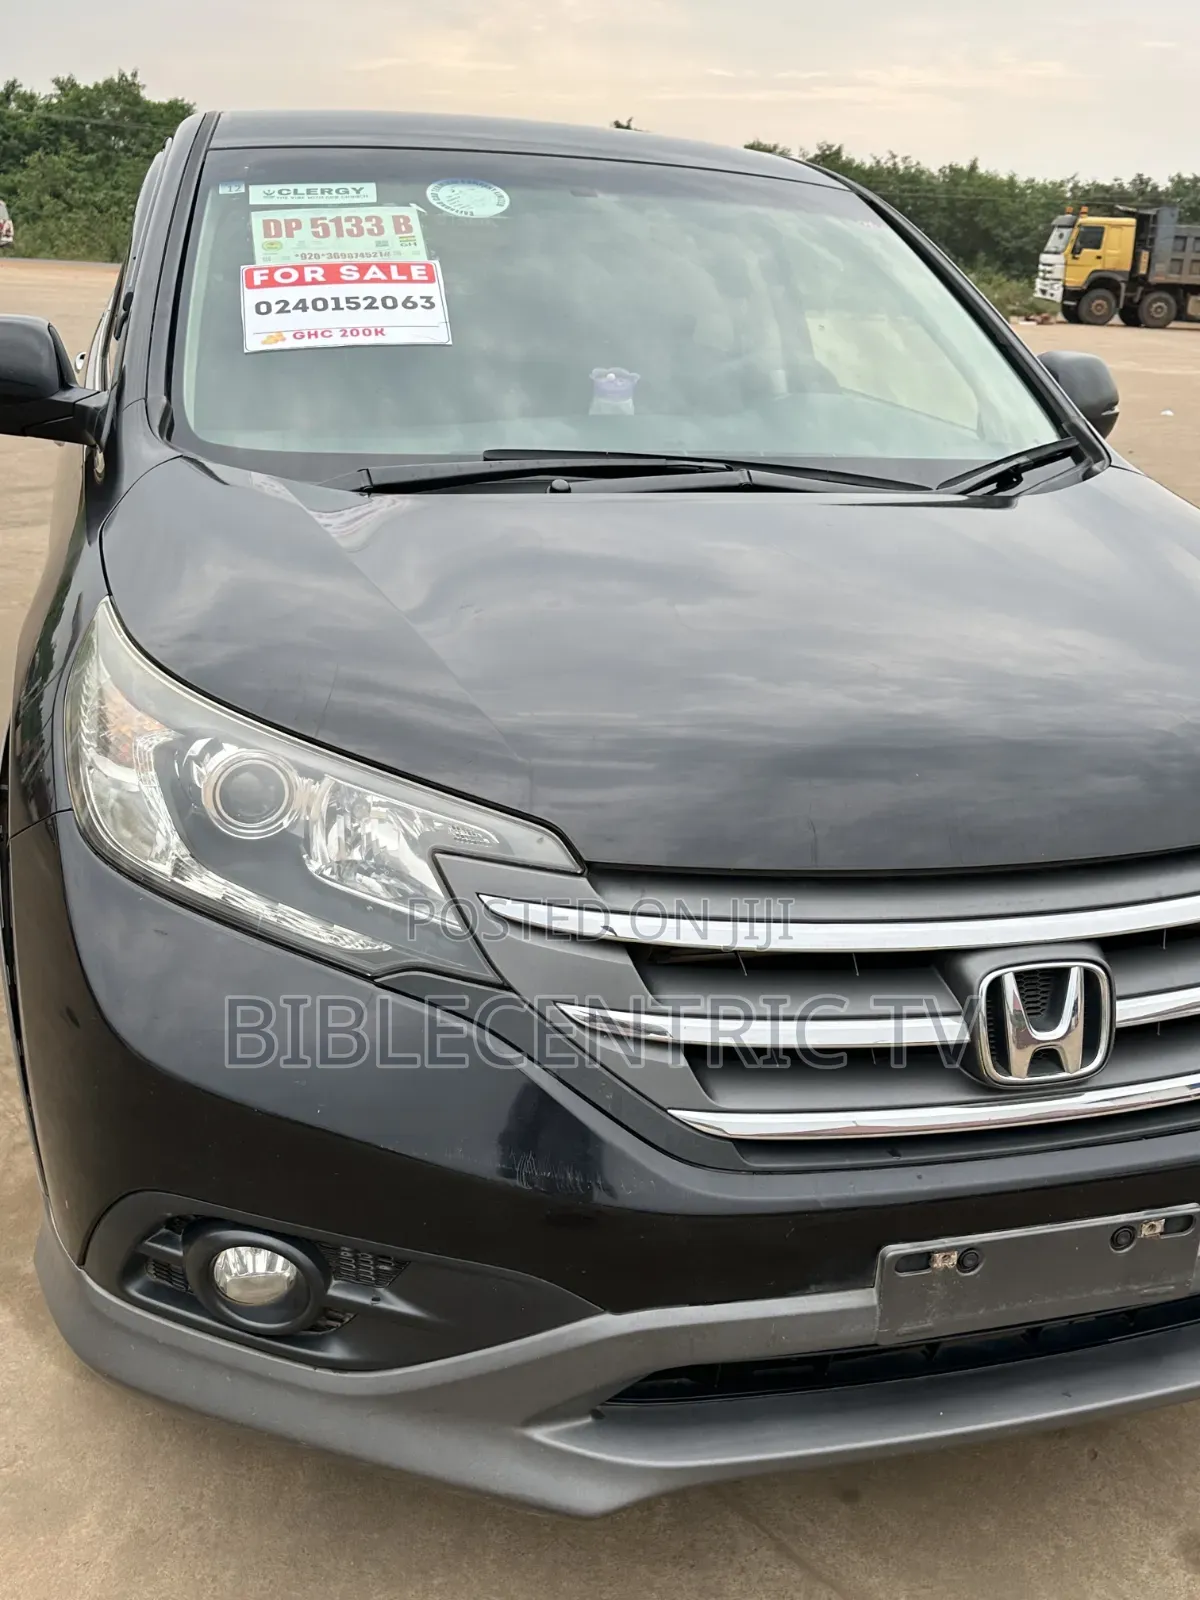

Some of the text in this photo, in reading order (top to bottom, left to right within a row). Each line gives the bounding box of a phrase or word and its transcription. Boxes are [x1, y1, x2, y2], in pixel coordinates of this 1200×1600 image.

[277, 186, 365, 196] CLERGY
[262, 214, 414, 239] DP 5133 B
[252, 264, 429, 286] FOR SALE
[254, 295, 436, 316] 0240152063
[292, 328, 387, 340] GHC 200K
